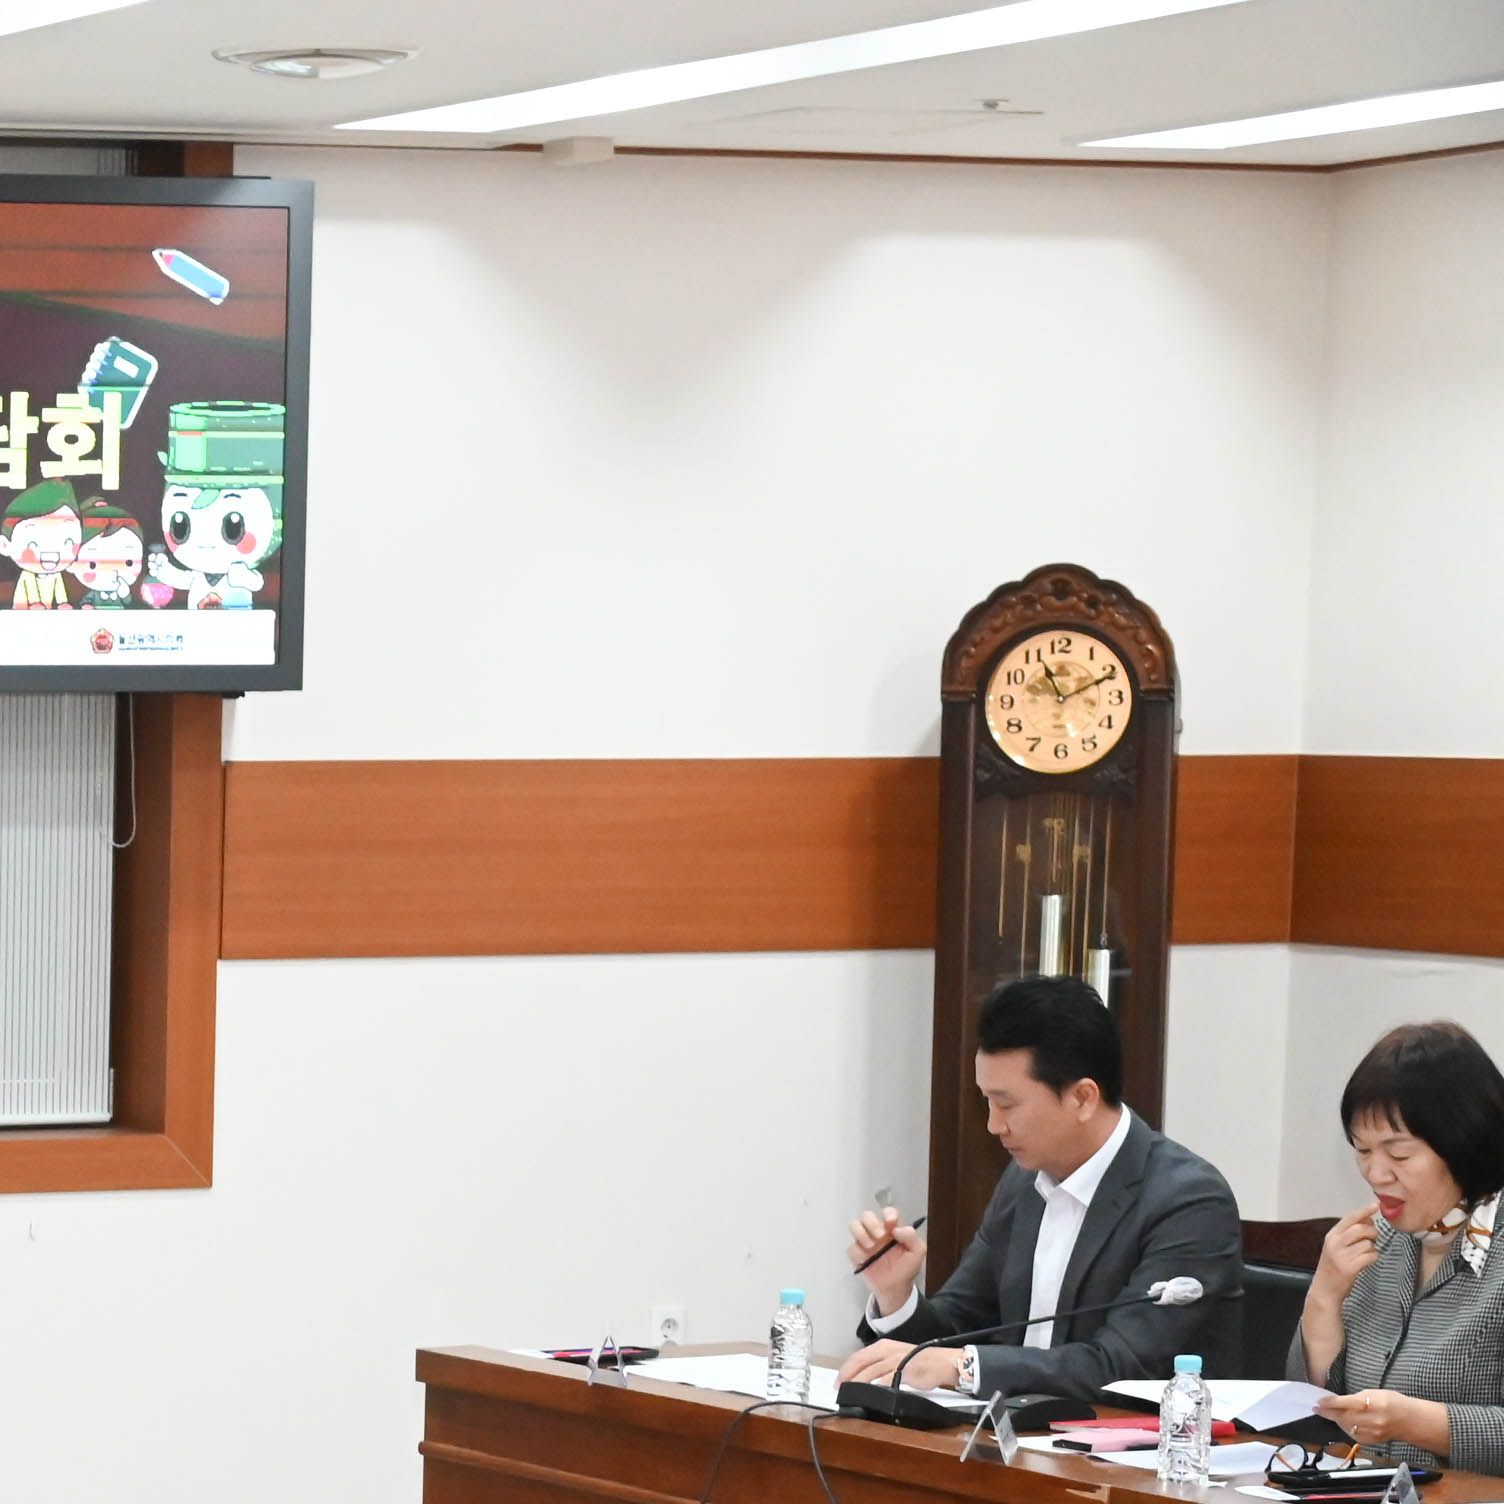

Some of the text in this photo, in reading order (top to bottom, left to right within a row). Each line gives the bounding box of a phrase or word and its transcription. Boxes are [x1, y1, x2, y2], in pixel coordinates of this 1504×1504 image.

[1050, 637, 1072, 655] 12
[1089, 646, 1094, 661] 1
[1025, 648, 1042, 664] 11
[1007, 668, 1025, 685] 10
[1102, 664, 1117, 680] 2
[1000, 694, 1014, 710] 9
[1108, 689, 1124, 705] 3
[1006, 717, 1023, 734] 8
[1098, 715, 1113, 729] 4
[1026, 737, 1041, 752] 7
[1054, 744, 1068, 759] 6
[1082, 735, 1097, 752] 5
